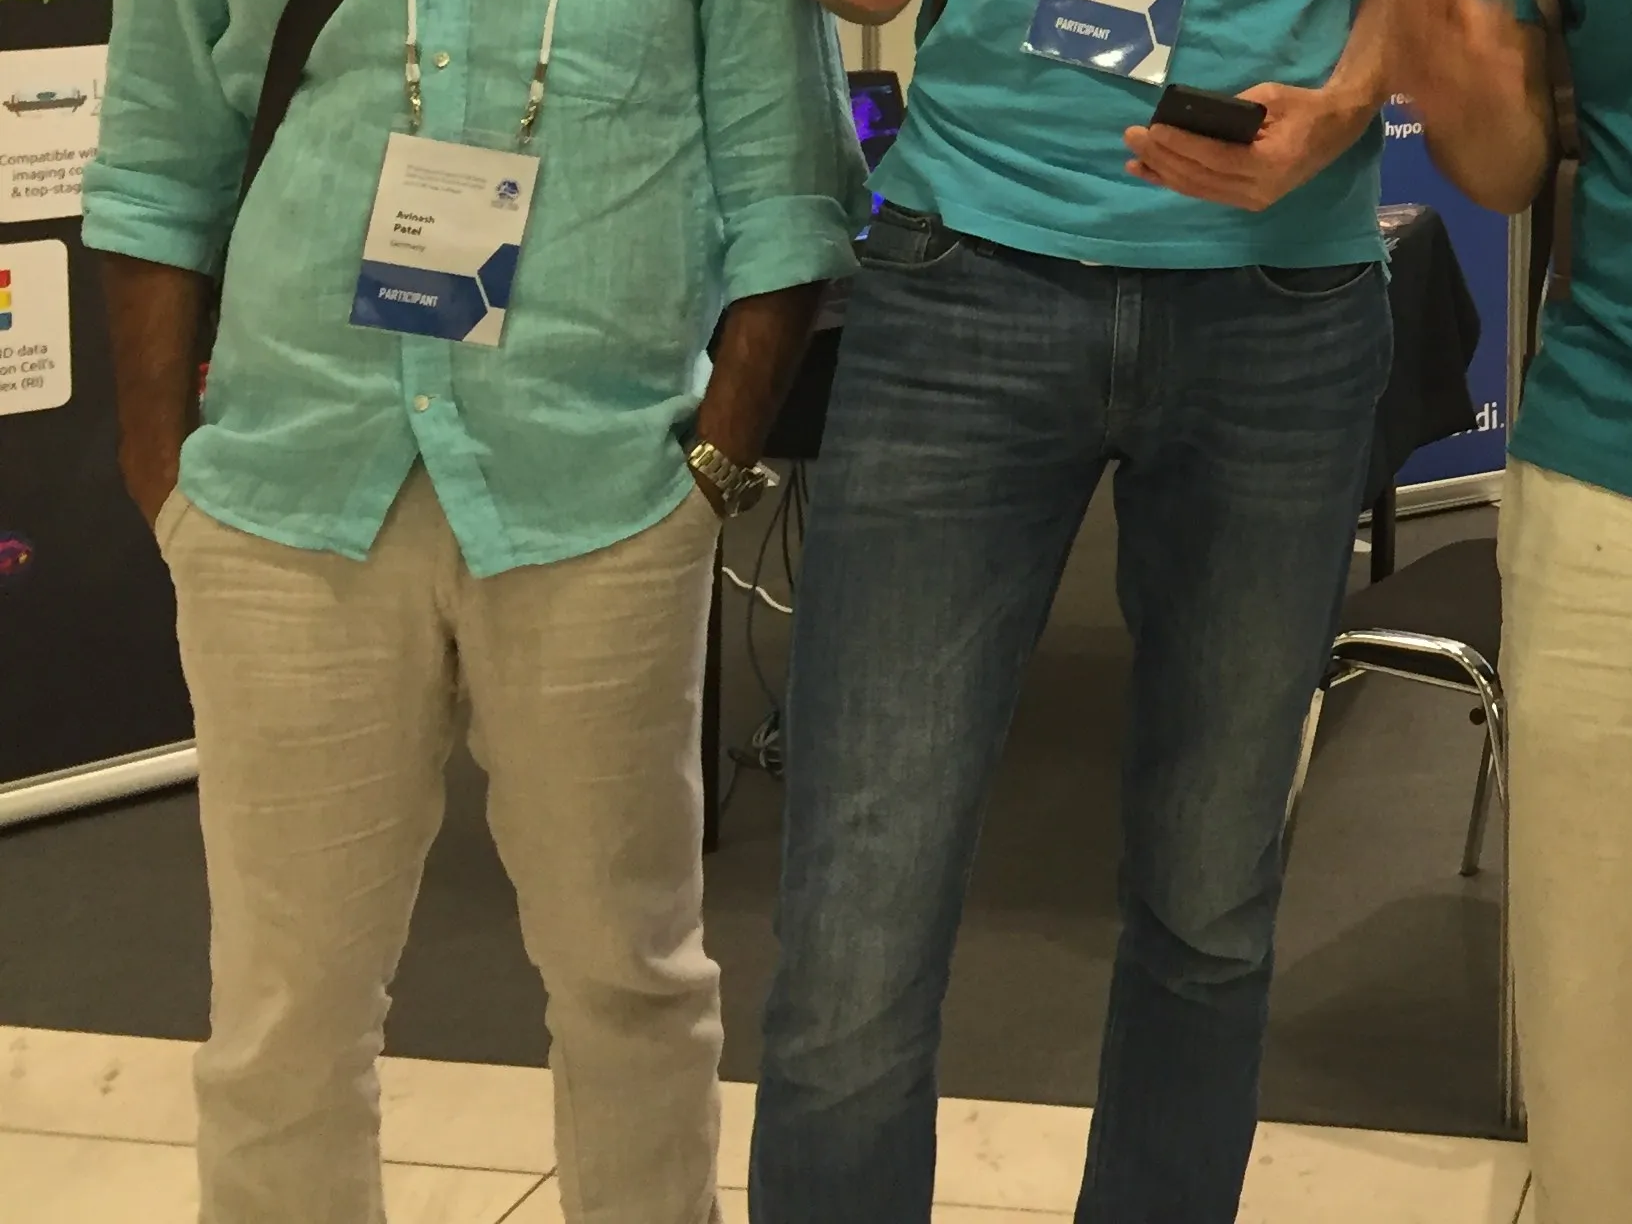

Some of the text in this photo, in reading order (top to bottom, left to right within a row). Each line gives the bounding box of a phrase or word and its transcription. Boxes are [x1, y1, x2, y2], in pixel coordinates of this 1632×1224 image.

[1055, 16, 1112, 41] PARTICIPANT
[1385, 120, 1424, 140] hypo
[378, 286, 439, 307] PARTICIPANT
